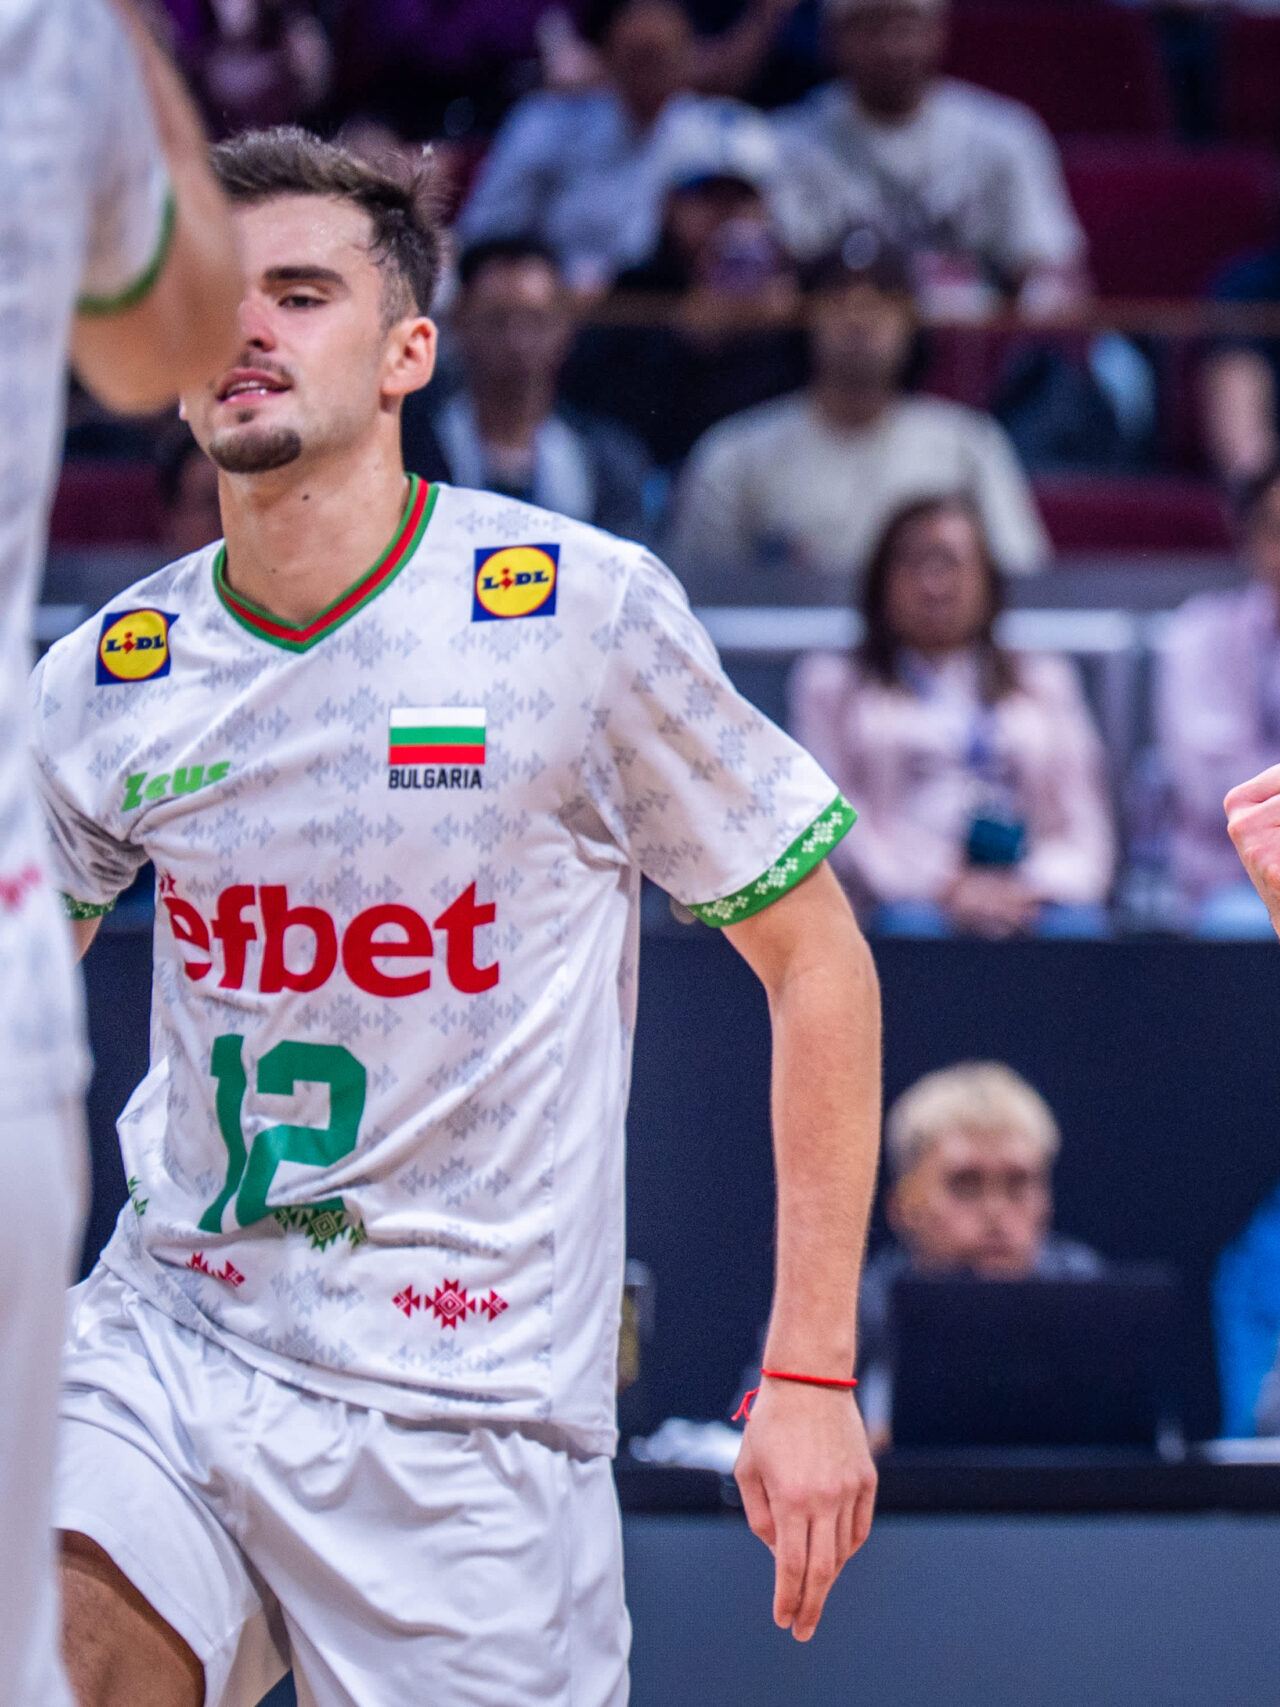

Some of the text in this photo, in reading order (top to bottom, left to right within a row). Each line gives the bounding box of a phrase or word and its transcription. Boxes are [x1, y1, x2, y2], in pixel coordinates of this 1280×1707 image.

[388, 767, 483, 790] BULGARIA
[163, 880, 499, 998] efbet
[197, 1033, 367, 1234] 12
